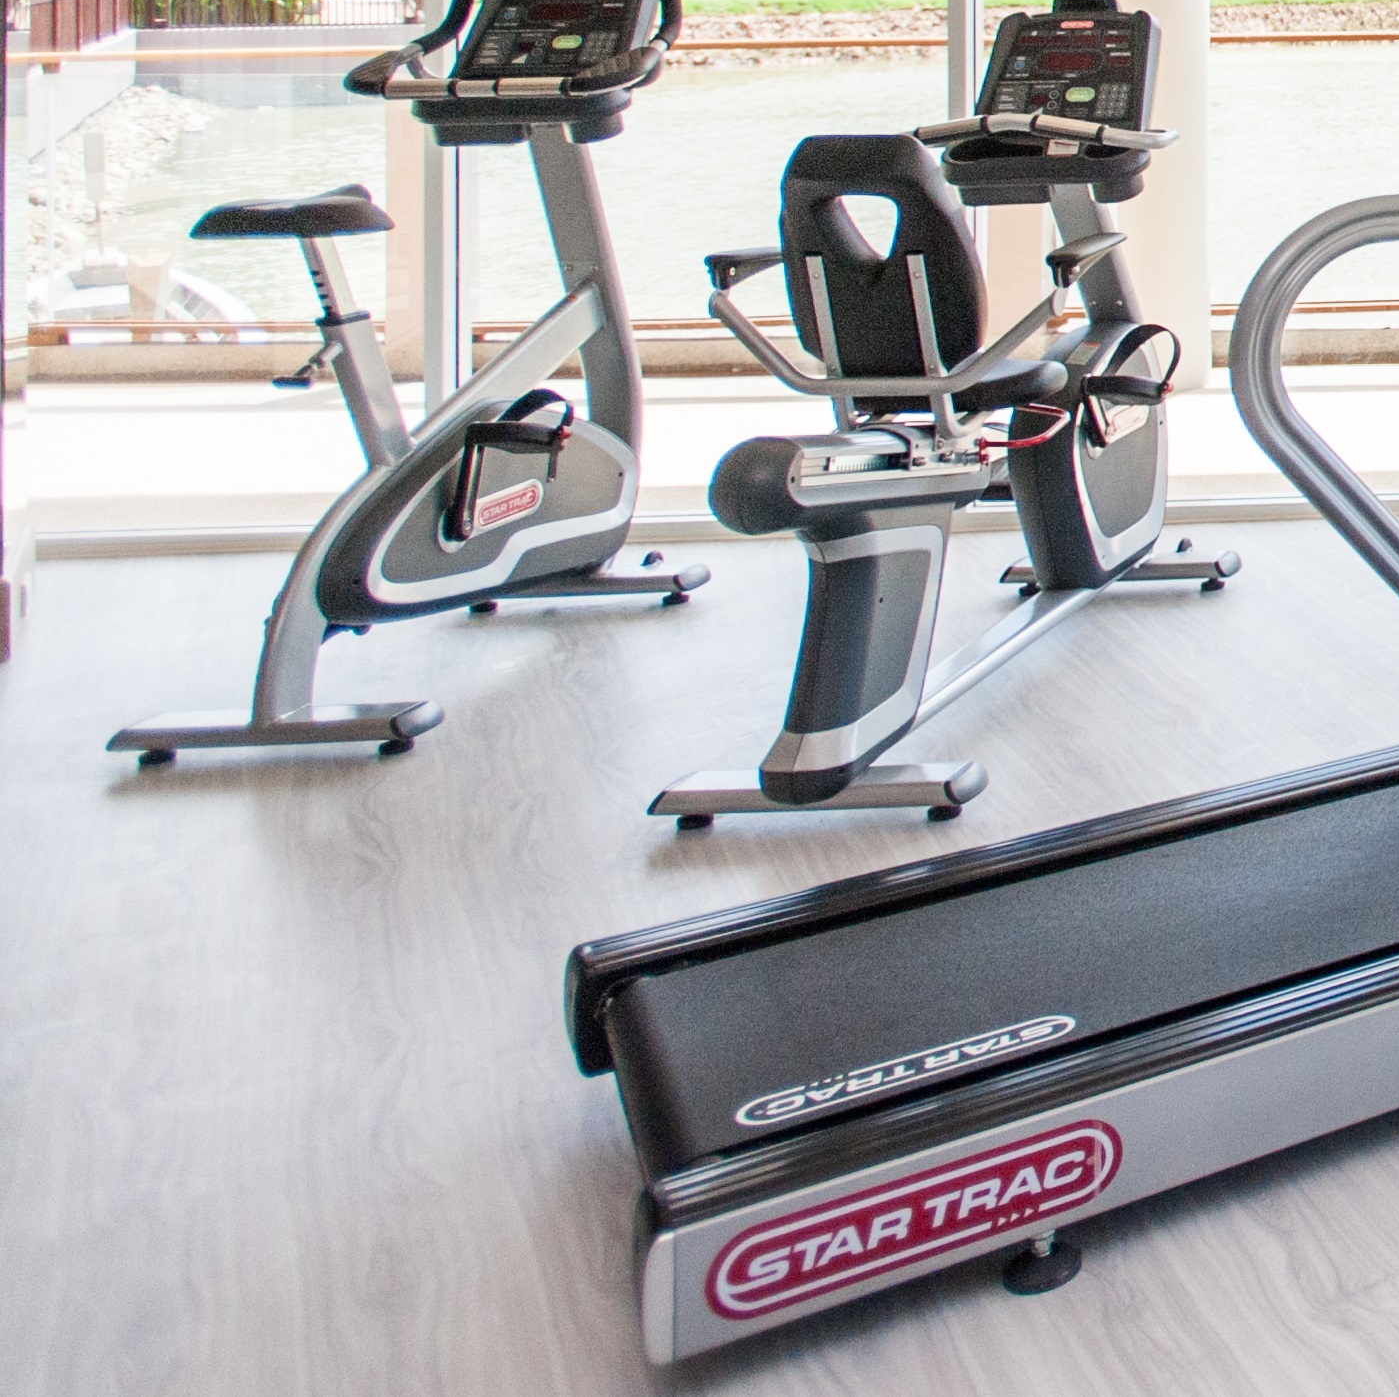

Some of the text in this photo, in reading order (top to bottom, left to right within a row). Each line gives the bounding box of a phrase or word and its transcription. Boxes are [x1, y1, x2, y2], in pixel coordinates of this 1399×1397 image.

[482, 504, 508, 520] STAR
[766, 1024, 1053, 1117] STAR TRAC
[747, 1150, 1086, 1283] STAR TRAC
